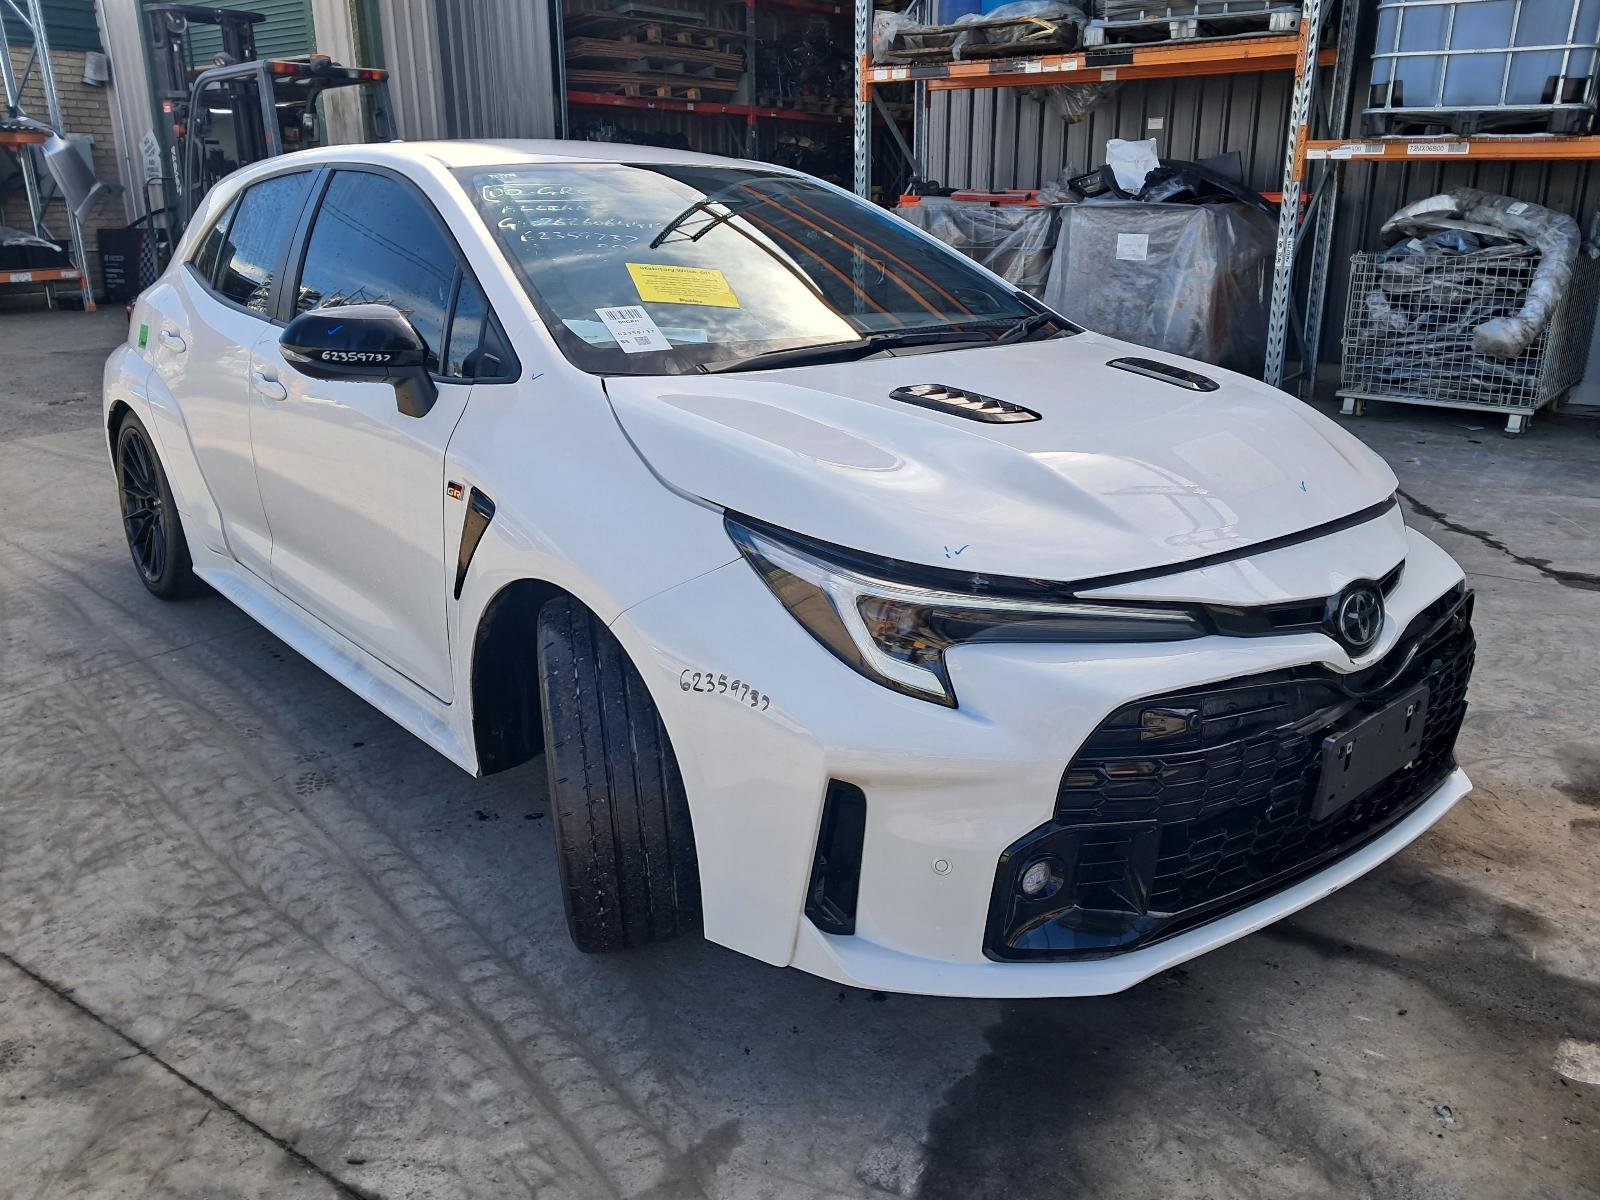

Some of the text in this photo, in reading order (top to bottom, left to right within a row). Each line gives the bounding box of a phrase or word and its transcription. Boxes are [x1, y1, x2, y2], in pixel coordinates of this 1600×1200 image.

[321, 351, 391, 362] 62359737
[447, 487, 462, 499] GR
[680, 669, 770, 711] 62359737
